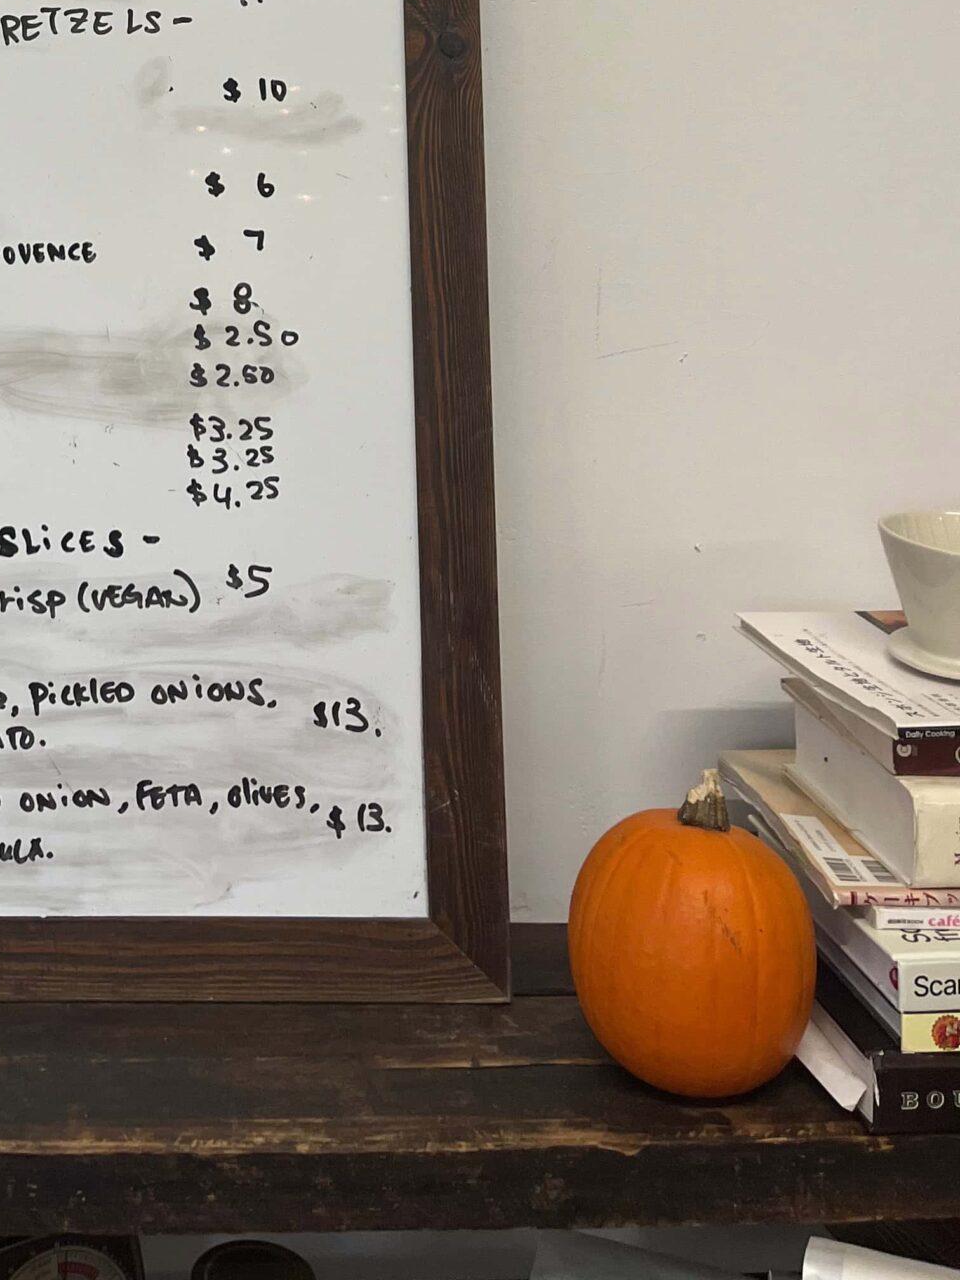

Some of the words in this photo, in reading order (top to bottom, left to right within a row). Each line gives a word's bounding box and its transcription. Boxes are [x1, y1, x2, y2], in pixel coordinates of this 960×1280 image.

[77, 568, 201, 614] (VEGAN)
[225, 563, 273, 599] $5
[925, 730, 955, 738] Cooking
[135, 779, 219, 816] FETA,
[913, 975, 960, 997] Sca
